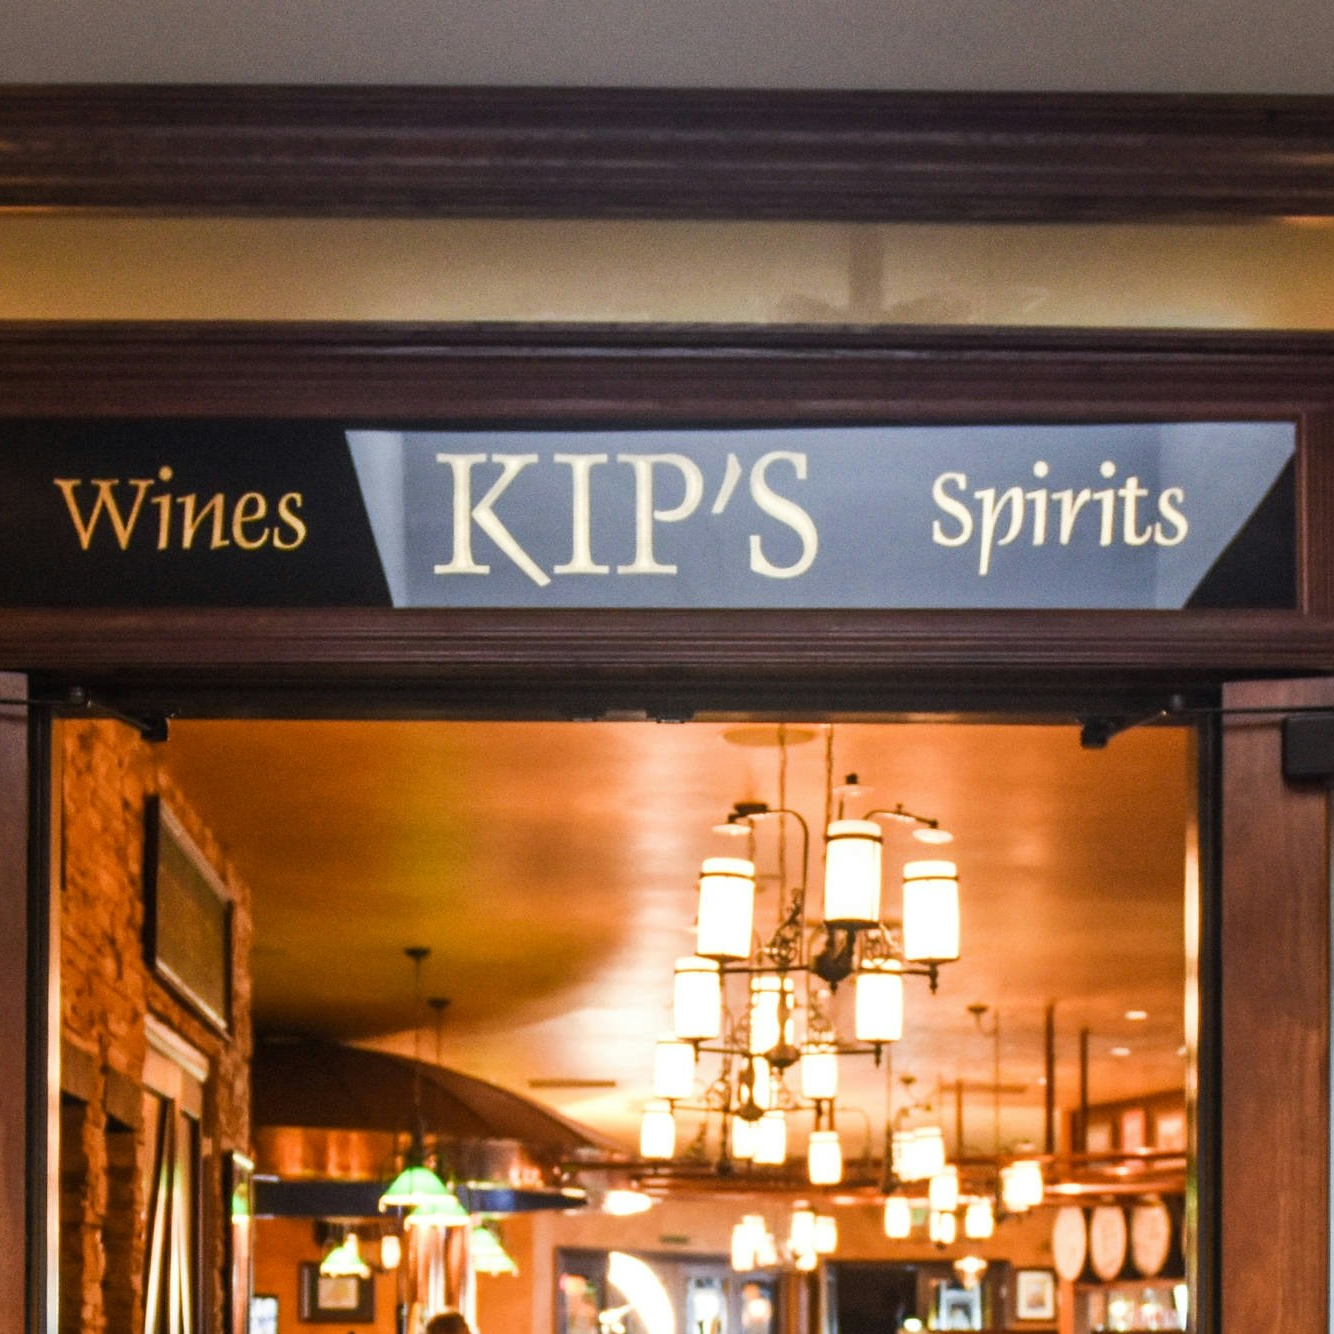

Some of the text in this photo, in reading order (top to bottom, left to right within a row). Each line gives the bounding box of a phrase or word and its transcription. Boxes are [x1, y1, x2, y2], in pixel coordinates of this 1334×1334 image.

[54, 466, 307, 551] Wines
[433, 450, 820, 587] KIP'S
[931, 460, 1190, 576] Spirits
